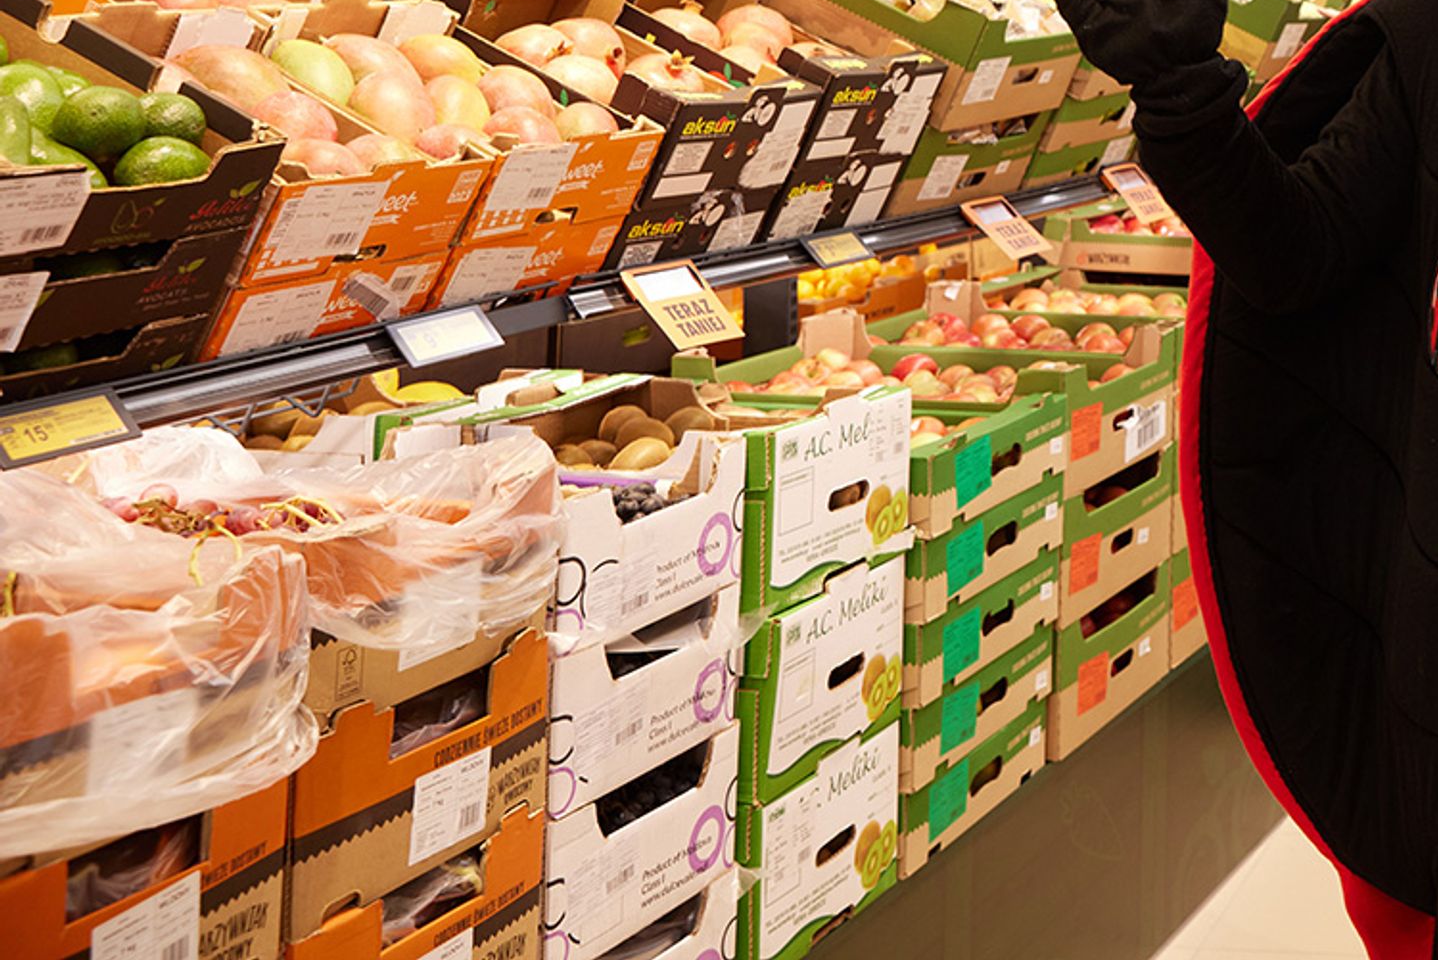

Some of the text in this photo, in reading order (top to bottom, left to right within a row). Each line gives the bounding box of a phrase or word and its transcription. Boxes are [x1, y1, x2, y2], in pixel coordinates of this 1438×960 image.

[833, 86, 877, 105] aksun
[682, 117, 736, 135] aksun
[628, 219, 685, 238] aksun
[663, 298, 714, 321] TERAZ
[676, 316, 726, 338] TANIEJ
[24, 425, 48, 443] 15
[839, 411, 870, 449] Mel
[838, 575, 889, 626] Meliki
[827, 747, 879, 802] Meliki
[643, 858, 671, 881] Product
[200, 902, 269, 949] ARZYWNIAK
